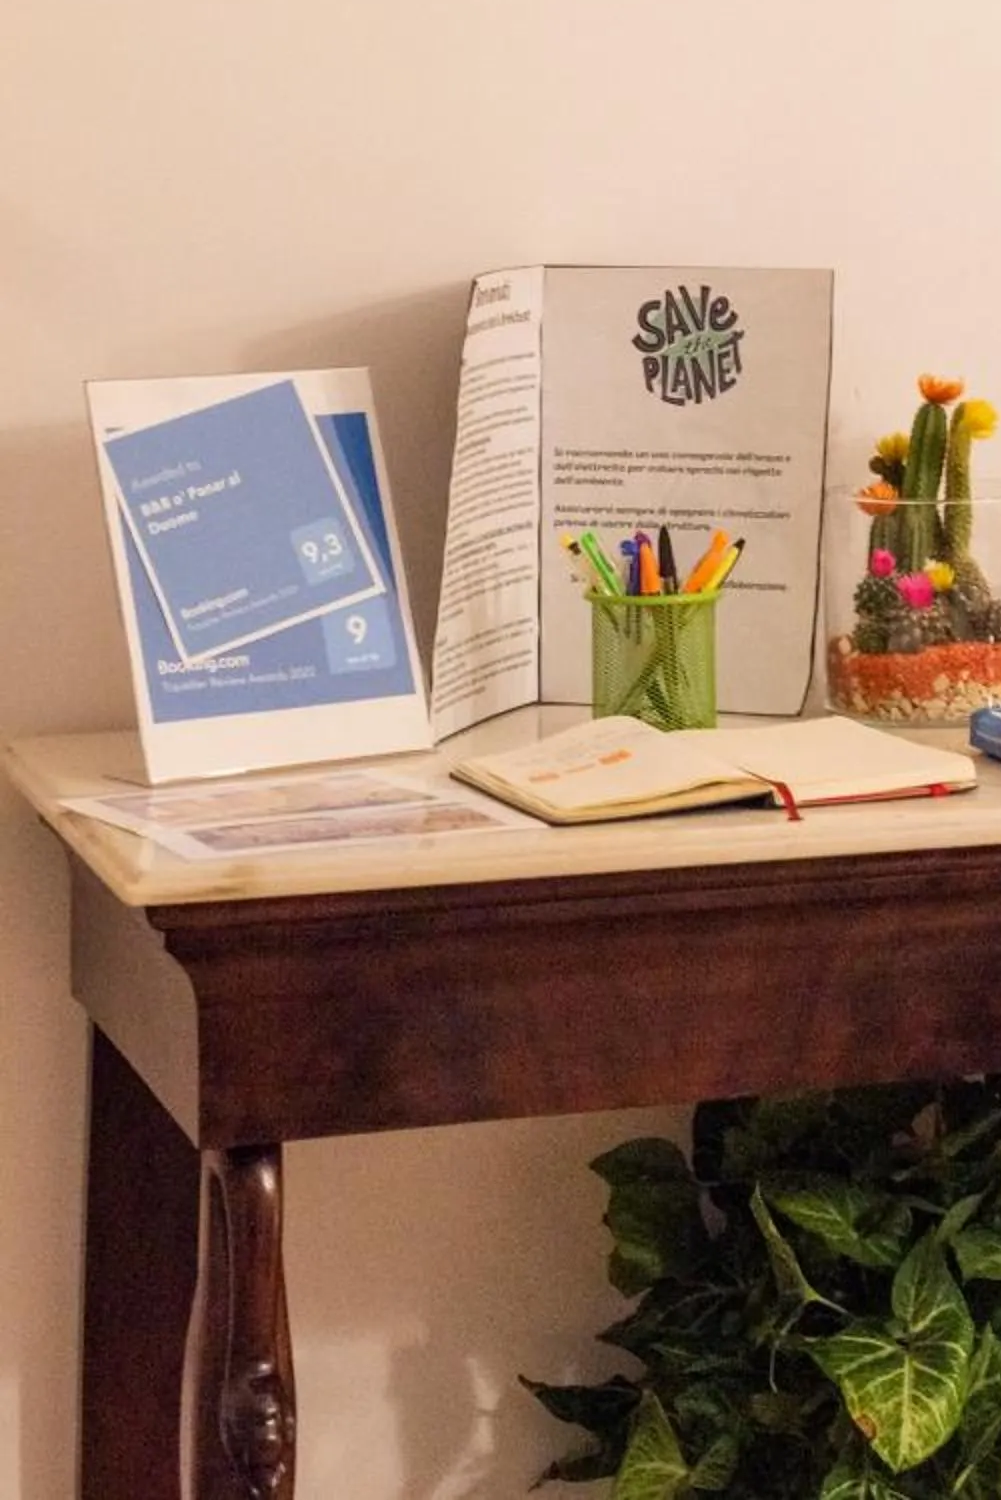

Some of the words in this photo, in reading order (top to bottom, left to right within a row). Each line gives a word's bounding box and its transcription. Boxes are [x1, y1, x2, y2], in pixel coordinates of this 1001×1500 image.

[642, 330, 745, 406] PLANET
[301, 533, 343, 565] 9,3
[346, 614, 368, 645] 9
